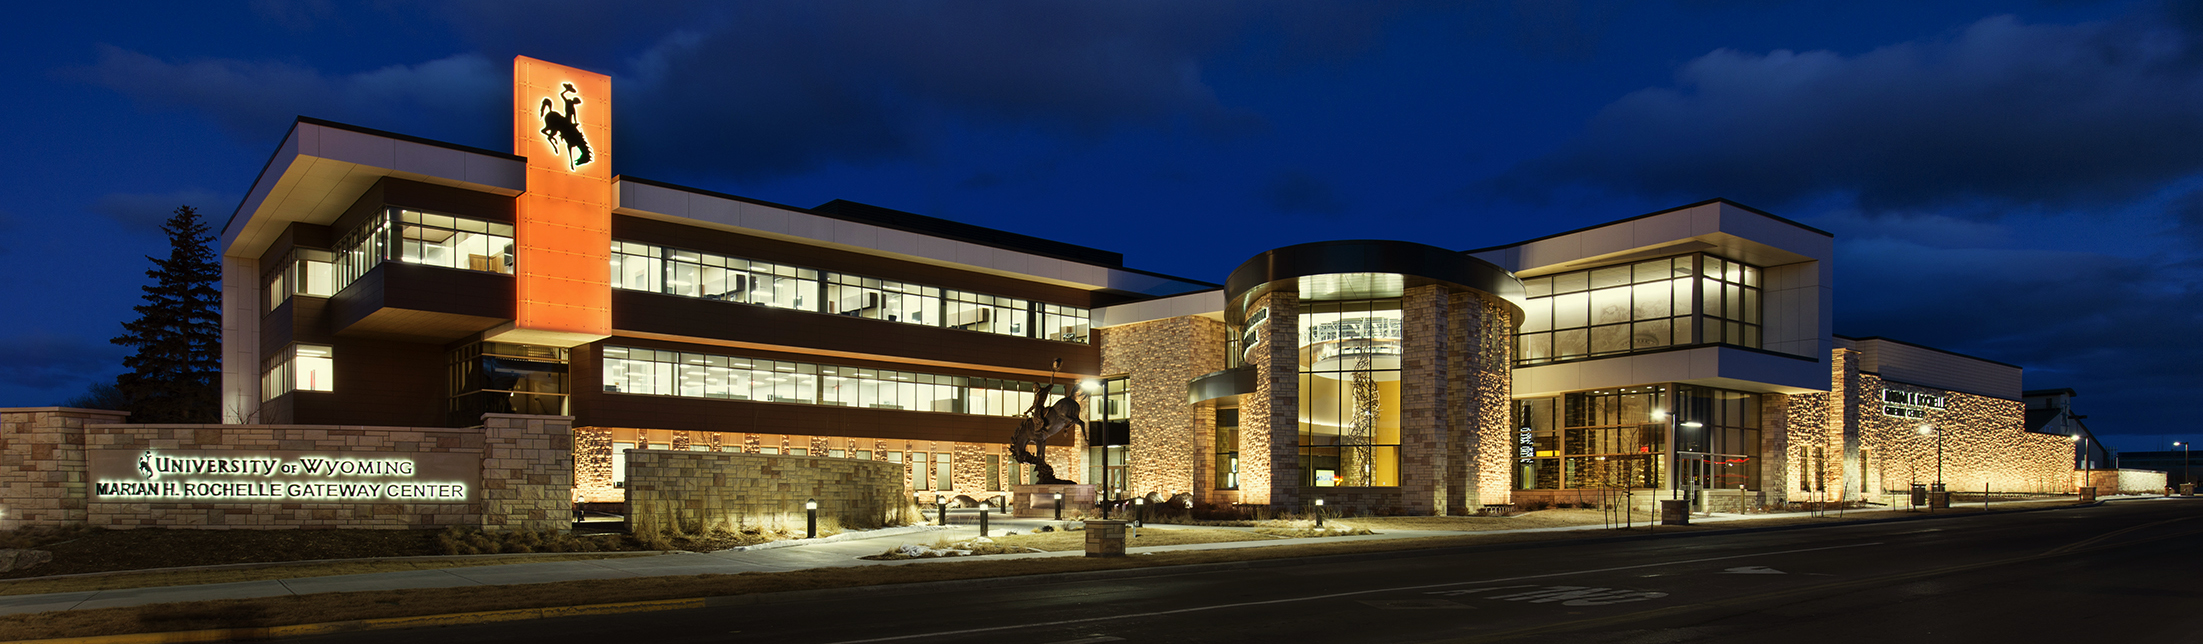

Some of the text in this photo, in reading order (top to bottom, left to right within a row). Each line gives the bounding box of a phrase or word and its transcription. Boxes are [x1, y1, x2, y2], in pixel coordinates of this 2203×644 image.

[96, 482, 463, 497] MARIAN H. ROCHELLE GATEWAY CENTER
